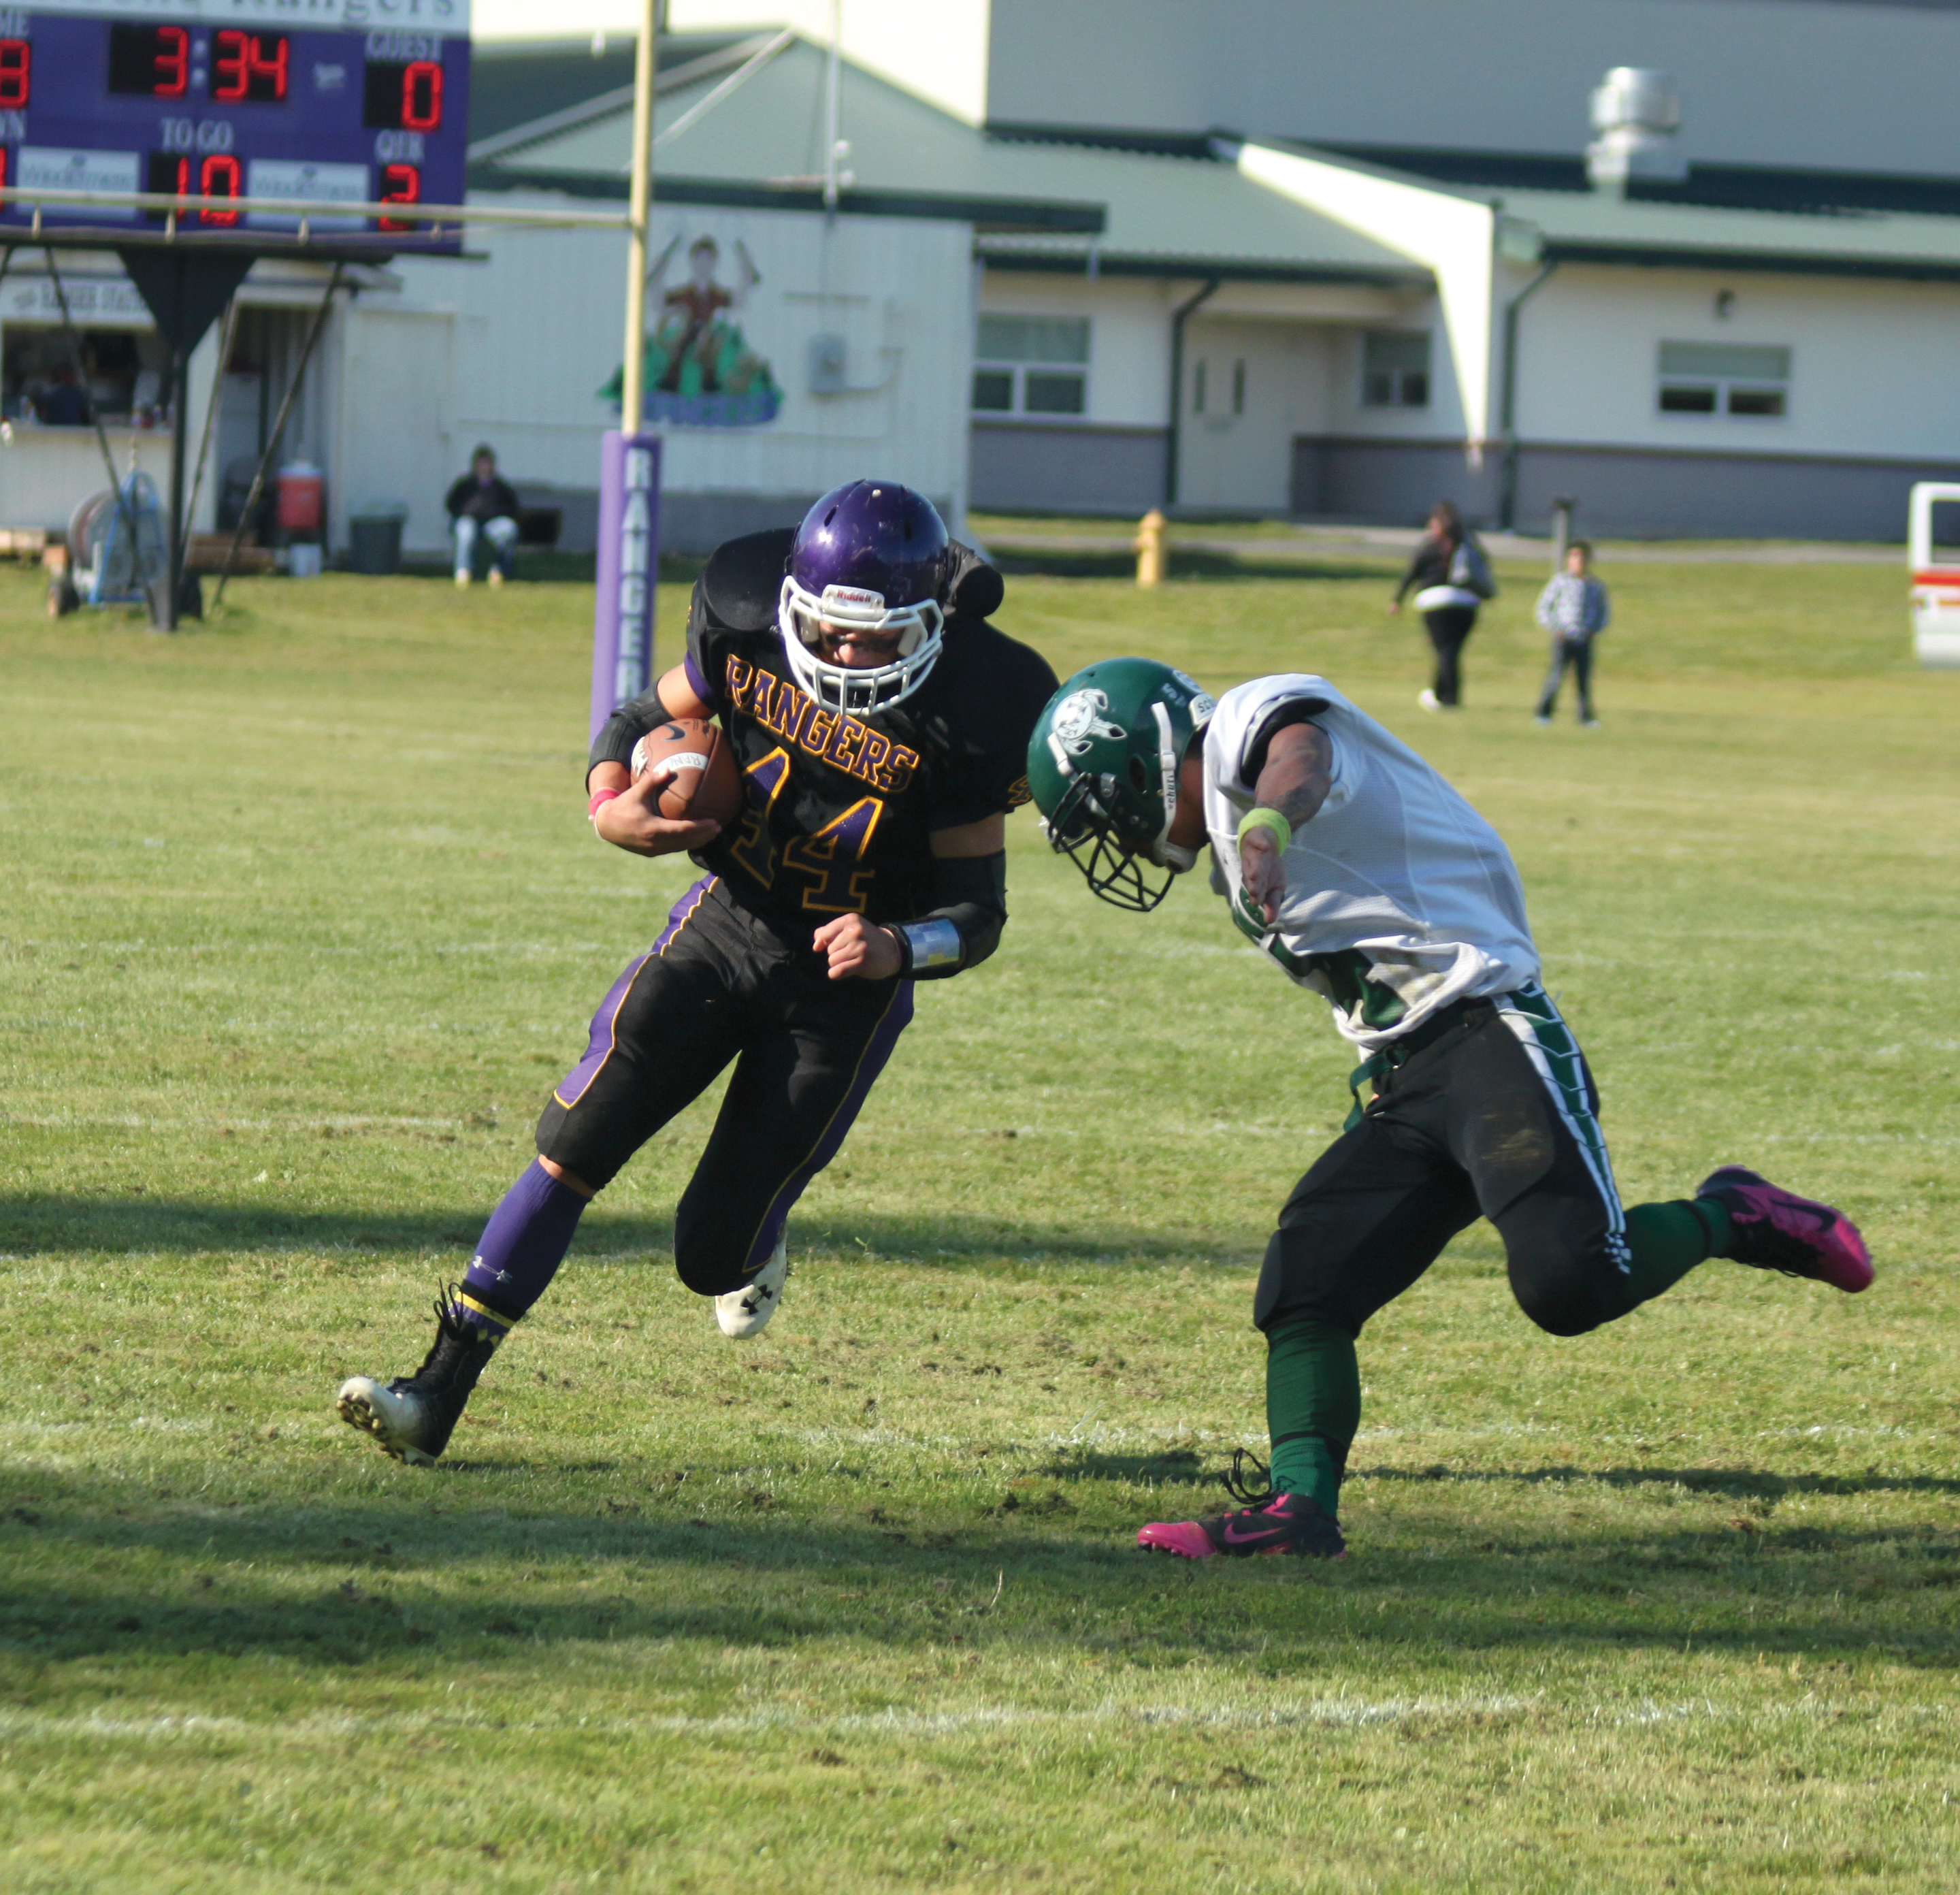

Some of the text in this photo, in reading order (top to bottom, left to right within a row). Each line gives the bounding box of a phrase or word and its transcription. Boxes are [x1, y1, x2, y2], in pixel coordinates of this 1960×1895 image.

[153, 27, 289, 101] 3:34
[365, 31, 442, 61] GUEST
[401, 61, 444, 132] 0
[161, 117, 234, 153] TO GO
[177, 155, 241, 227] 10
[378, 163, 420, 232] 2
[615, 447, 653, 709] RANGER
[725, 653, 919, 793] RANGERS
[730, 746, 884, 913] 44
